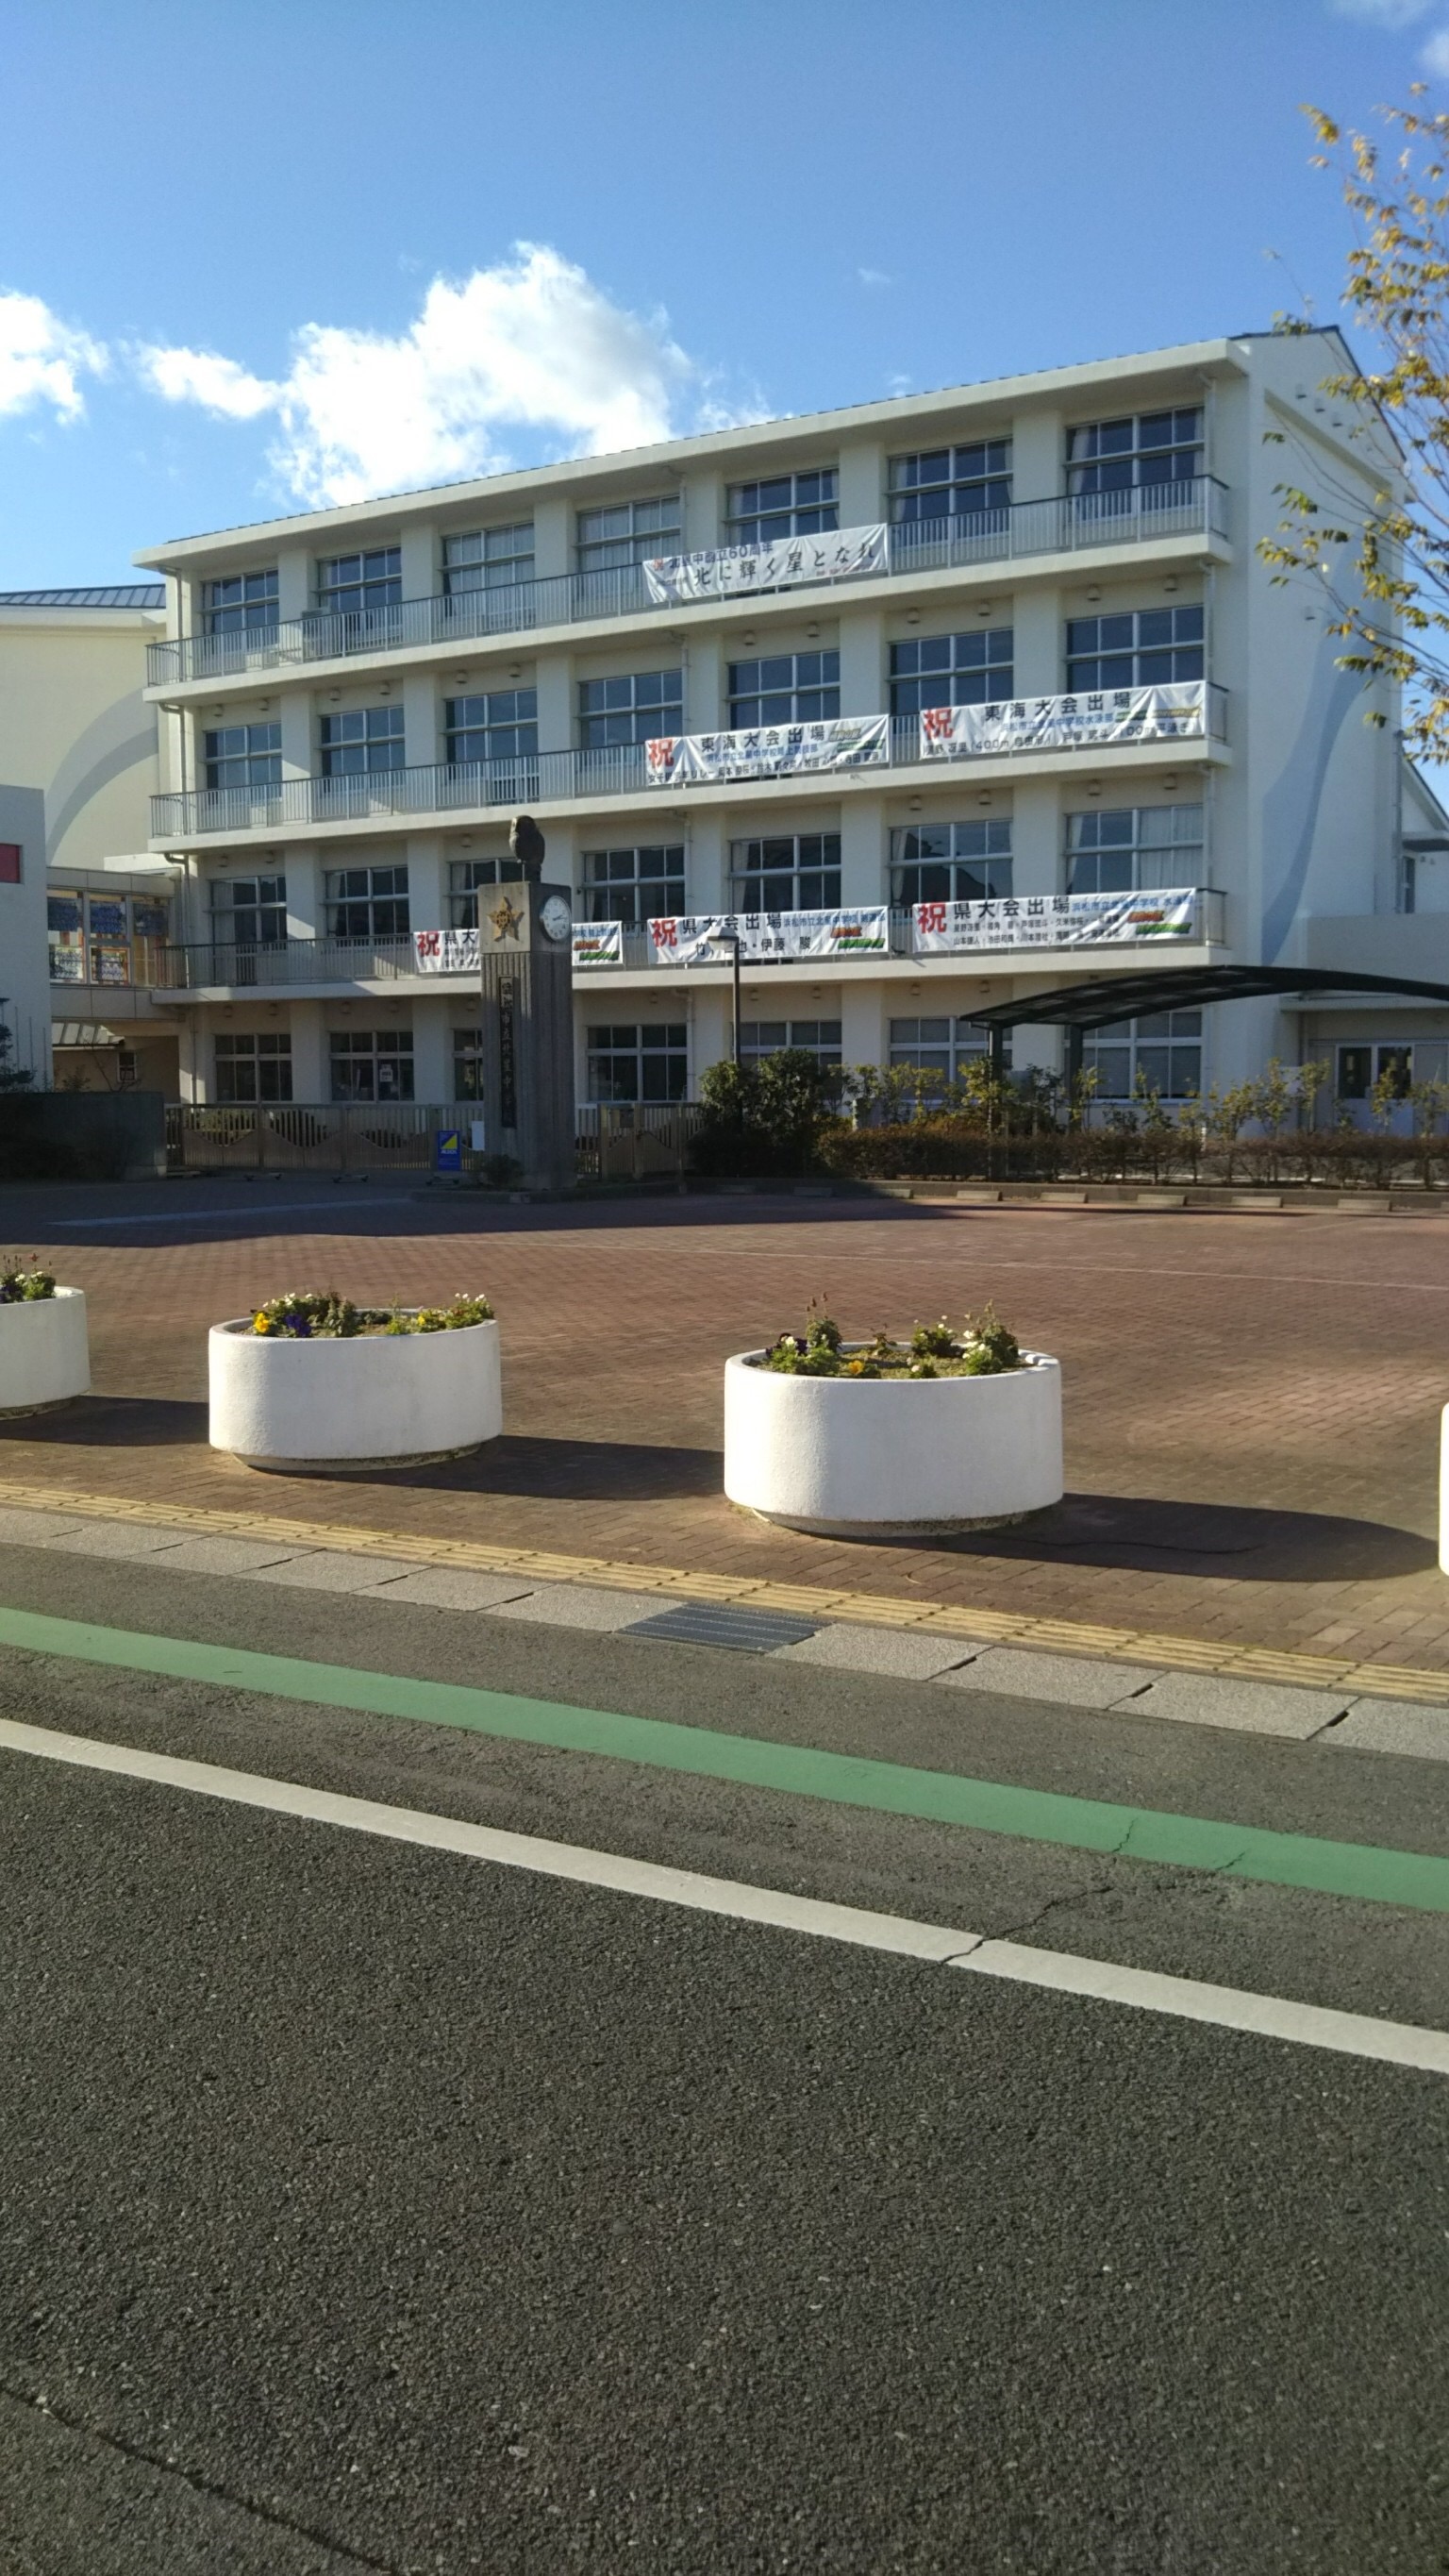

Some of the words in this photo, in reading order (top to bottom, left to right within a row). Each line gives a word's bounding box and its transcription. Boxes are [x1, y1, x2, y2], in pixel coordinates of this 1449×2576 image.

[694, 543, 874, 587] 北に輝く星となれ
[985, 692, 1130, 722] 東海大会出場
[701, 725, 824, 752] 東海大会出場
[923, 709, 954, 740] 祝
[648, 739, 674, 768] 祝
[918, 902, 946, 934] 祝
[954, 896, 1070, 920] 県大会出場
[652, 919, 677, 947] 祝
[682, 912, 782, 934] 県大会出場
[417, 930, 440, 958] 祝
